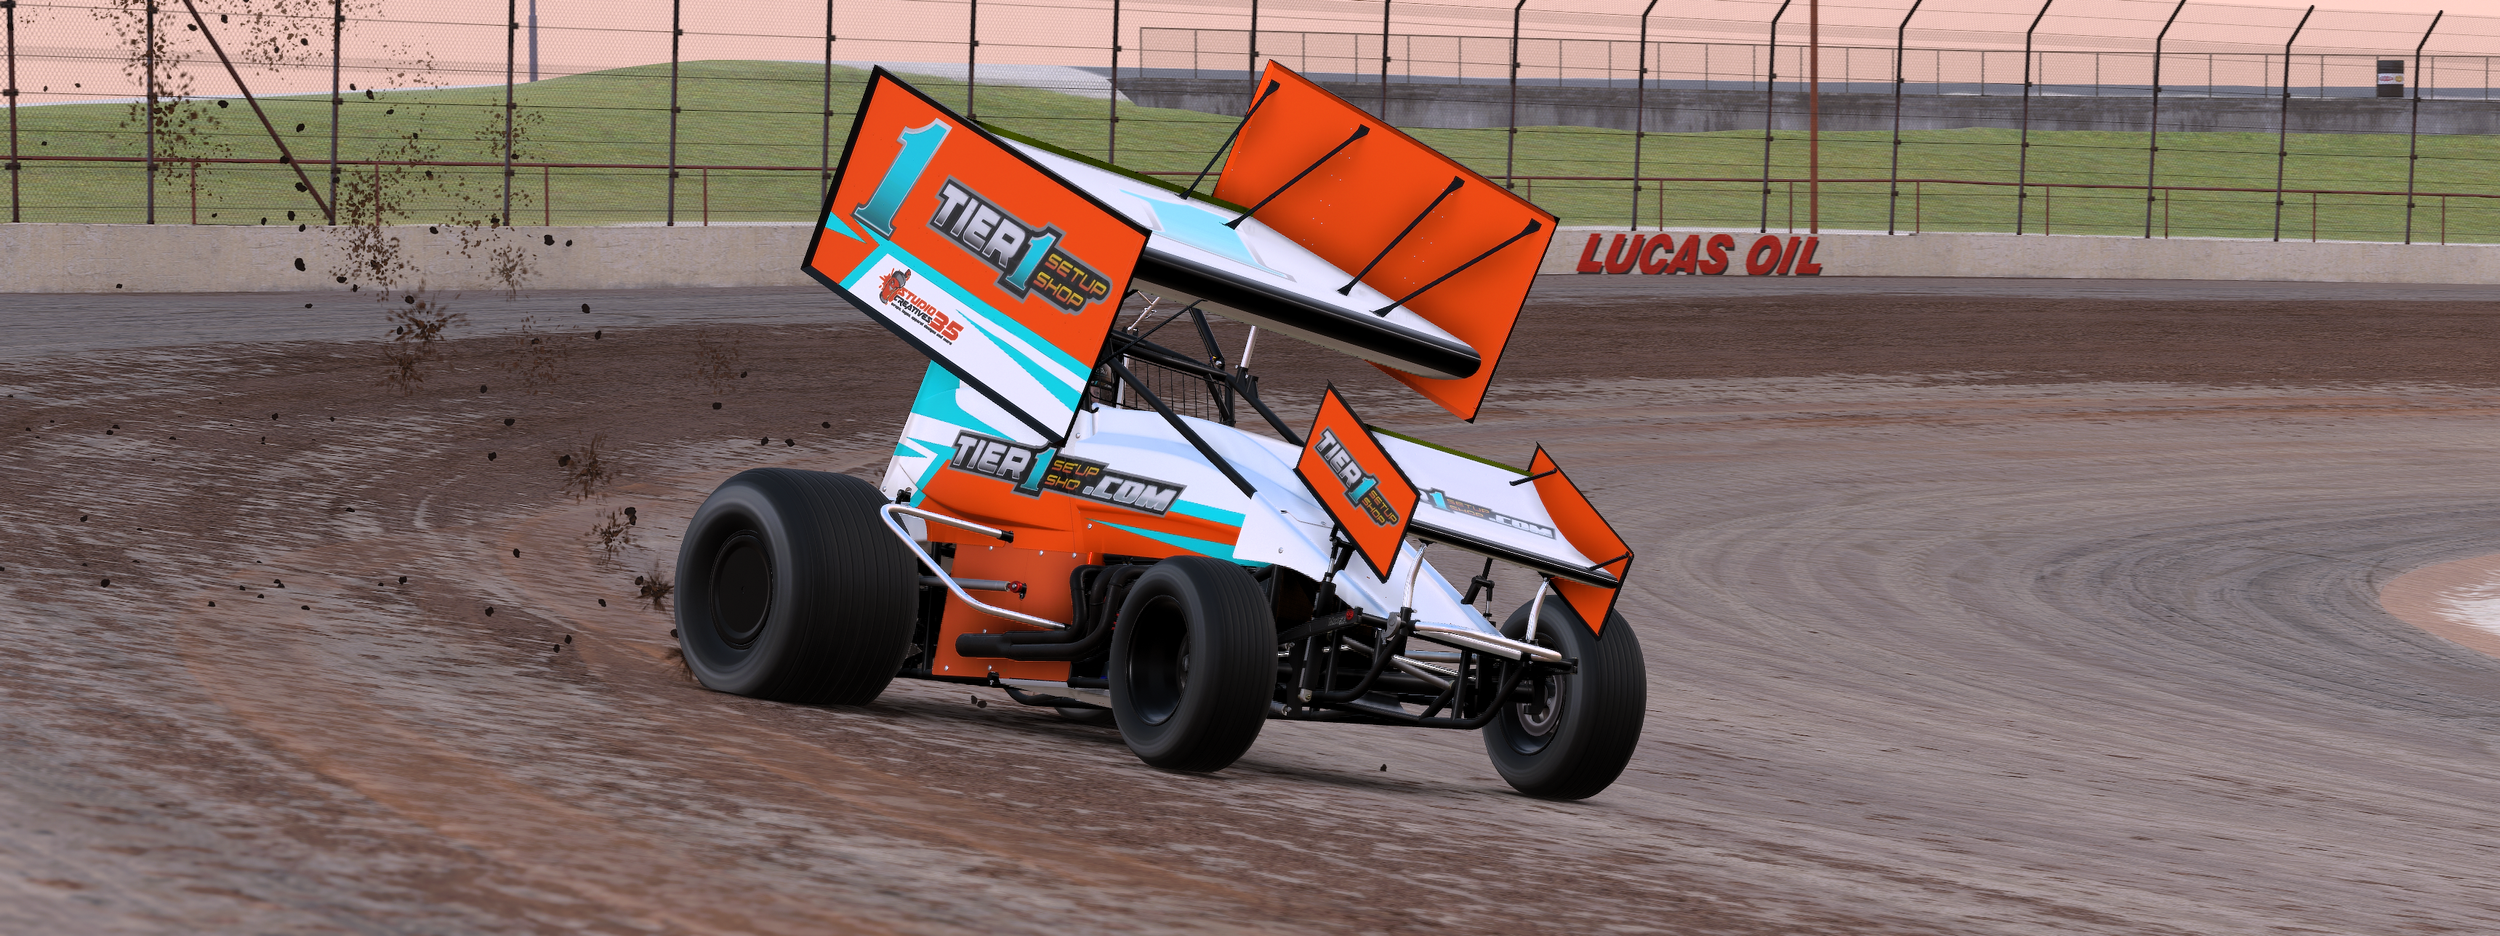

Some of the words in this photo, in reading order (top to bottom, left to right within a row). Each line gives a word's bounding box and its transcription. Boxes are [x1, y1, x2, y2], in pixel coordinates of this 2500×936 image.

[850, 118, 953, 240] 1
[1576, 233, 1735, 275] LUCAS
[1745, 235, 1822, 276] OIL
[1033, 271, 1084, 307] SHOP
[1045, 253, 1107, 296] SETUP
[893, 295, 933, 324] CREATIVES
[897, 287, 937, 316] STUDIO
[928, 310, 964, 341] 35
[1082, 475, 1177, 512] .COM
[1368, 490, 1397, 522] SETUP
[1446, 498, 1490, 514] SETUP
[1361, 497, 1386, 523] SHOP
[1449, 504, 1484, 518] SHOP
